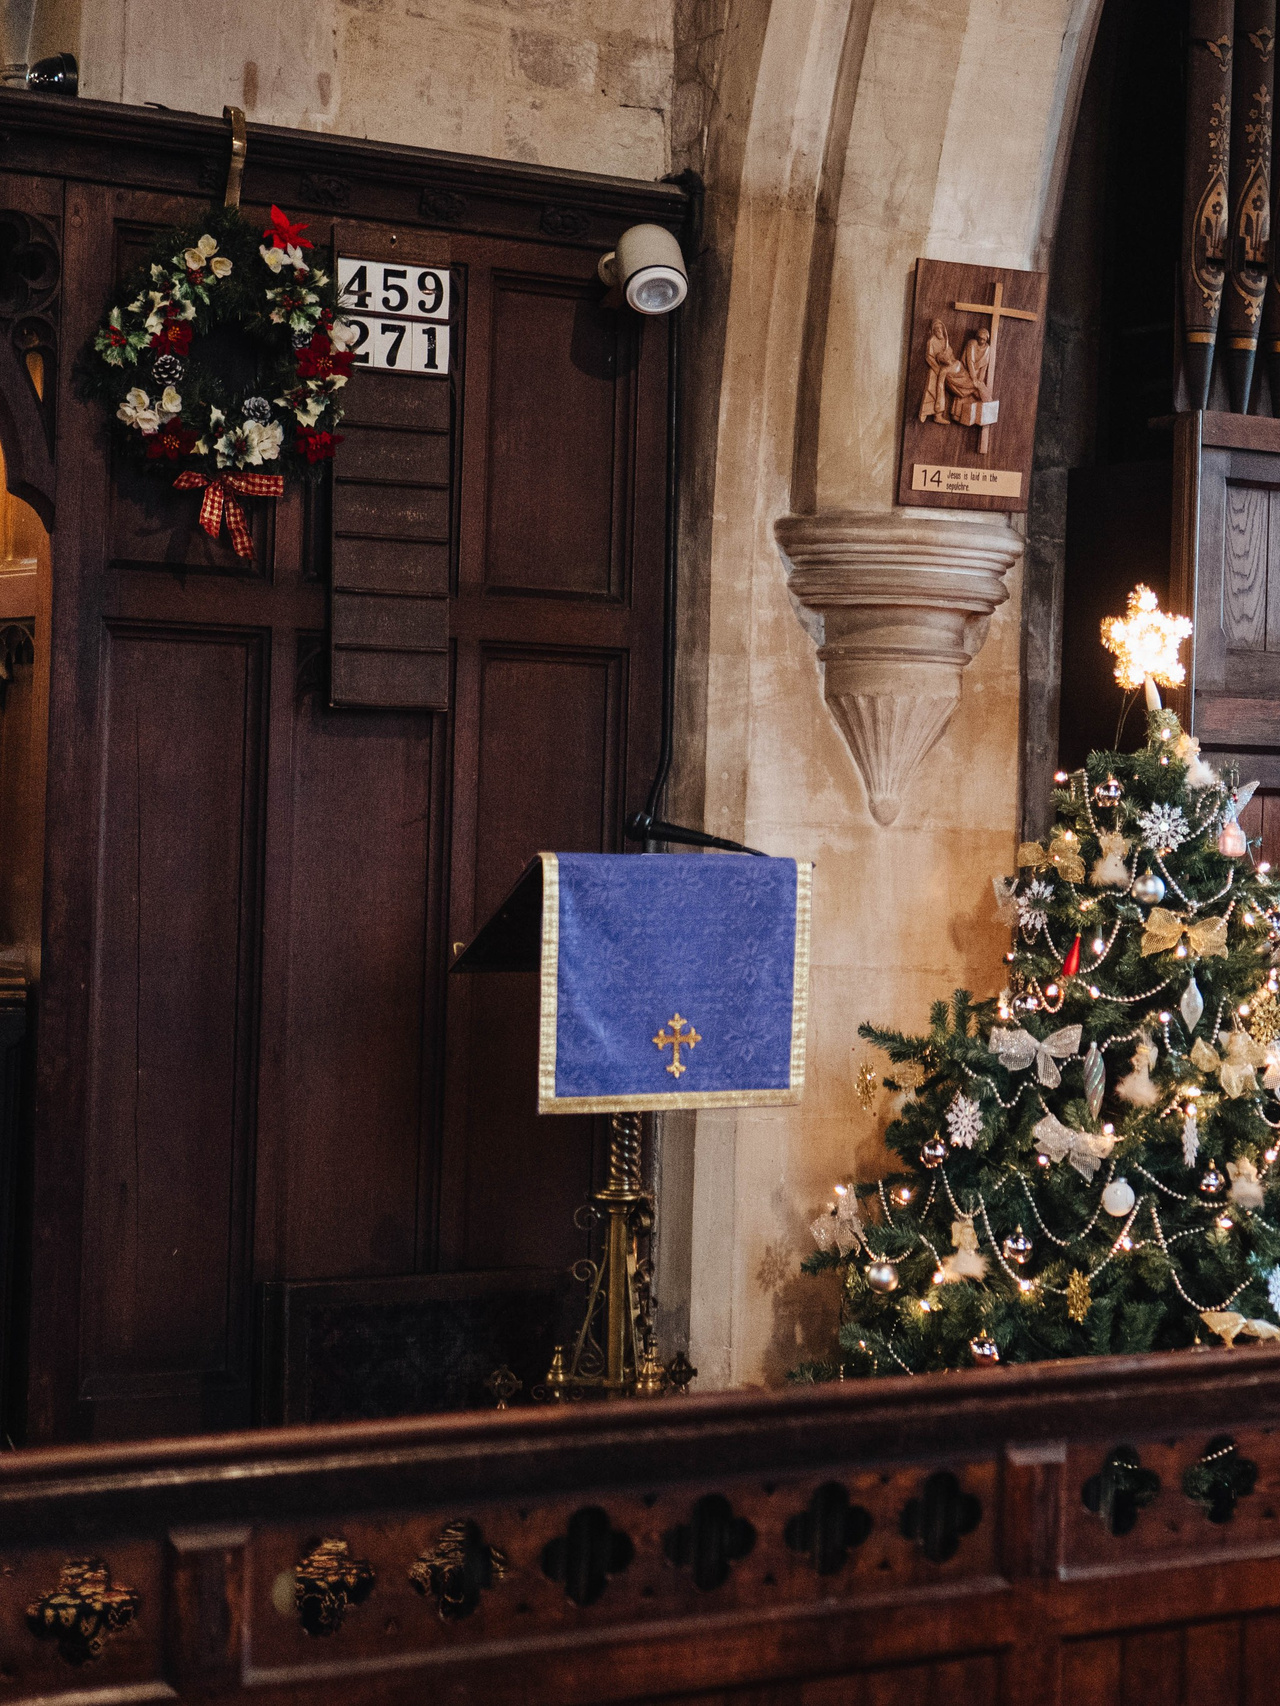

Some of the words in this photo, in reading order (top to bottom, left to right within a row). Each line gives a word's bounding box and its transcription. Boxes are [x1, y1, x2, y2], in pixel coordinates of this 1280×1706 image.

[343, 265, 444, 313] 459
[346, 320, 438, 369] 271
[922, 469, 942, 487] 14
[947, 470, 961, 480] Jesus
[971, 472, 980, 481] laid
[990, 473, 998, 482] the
